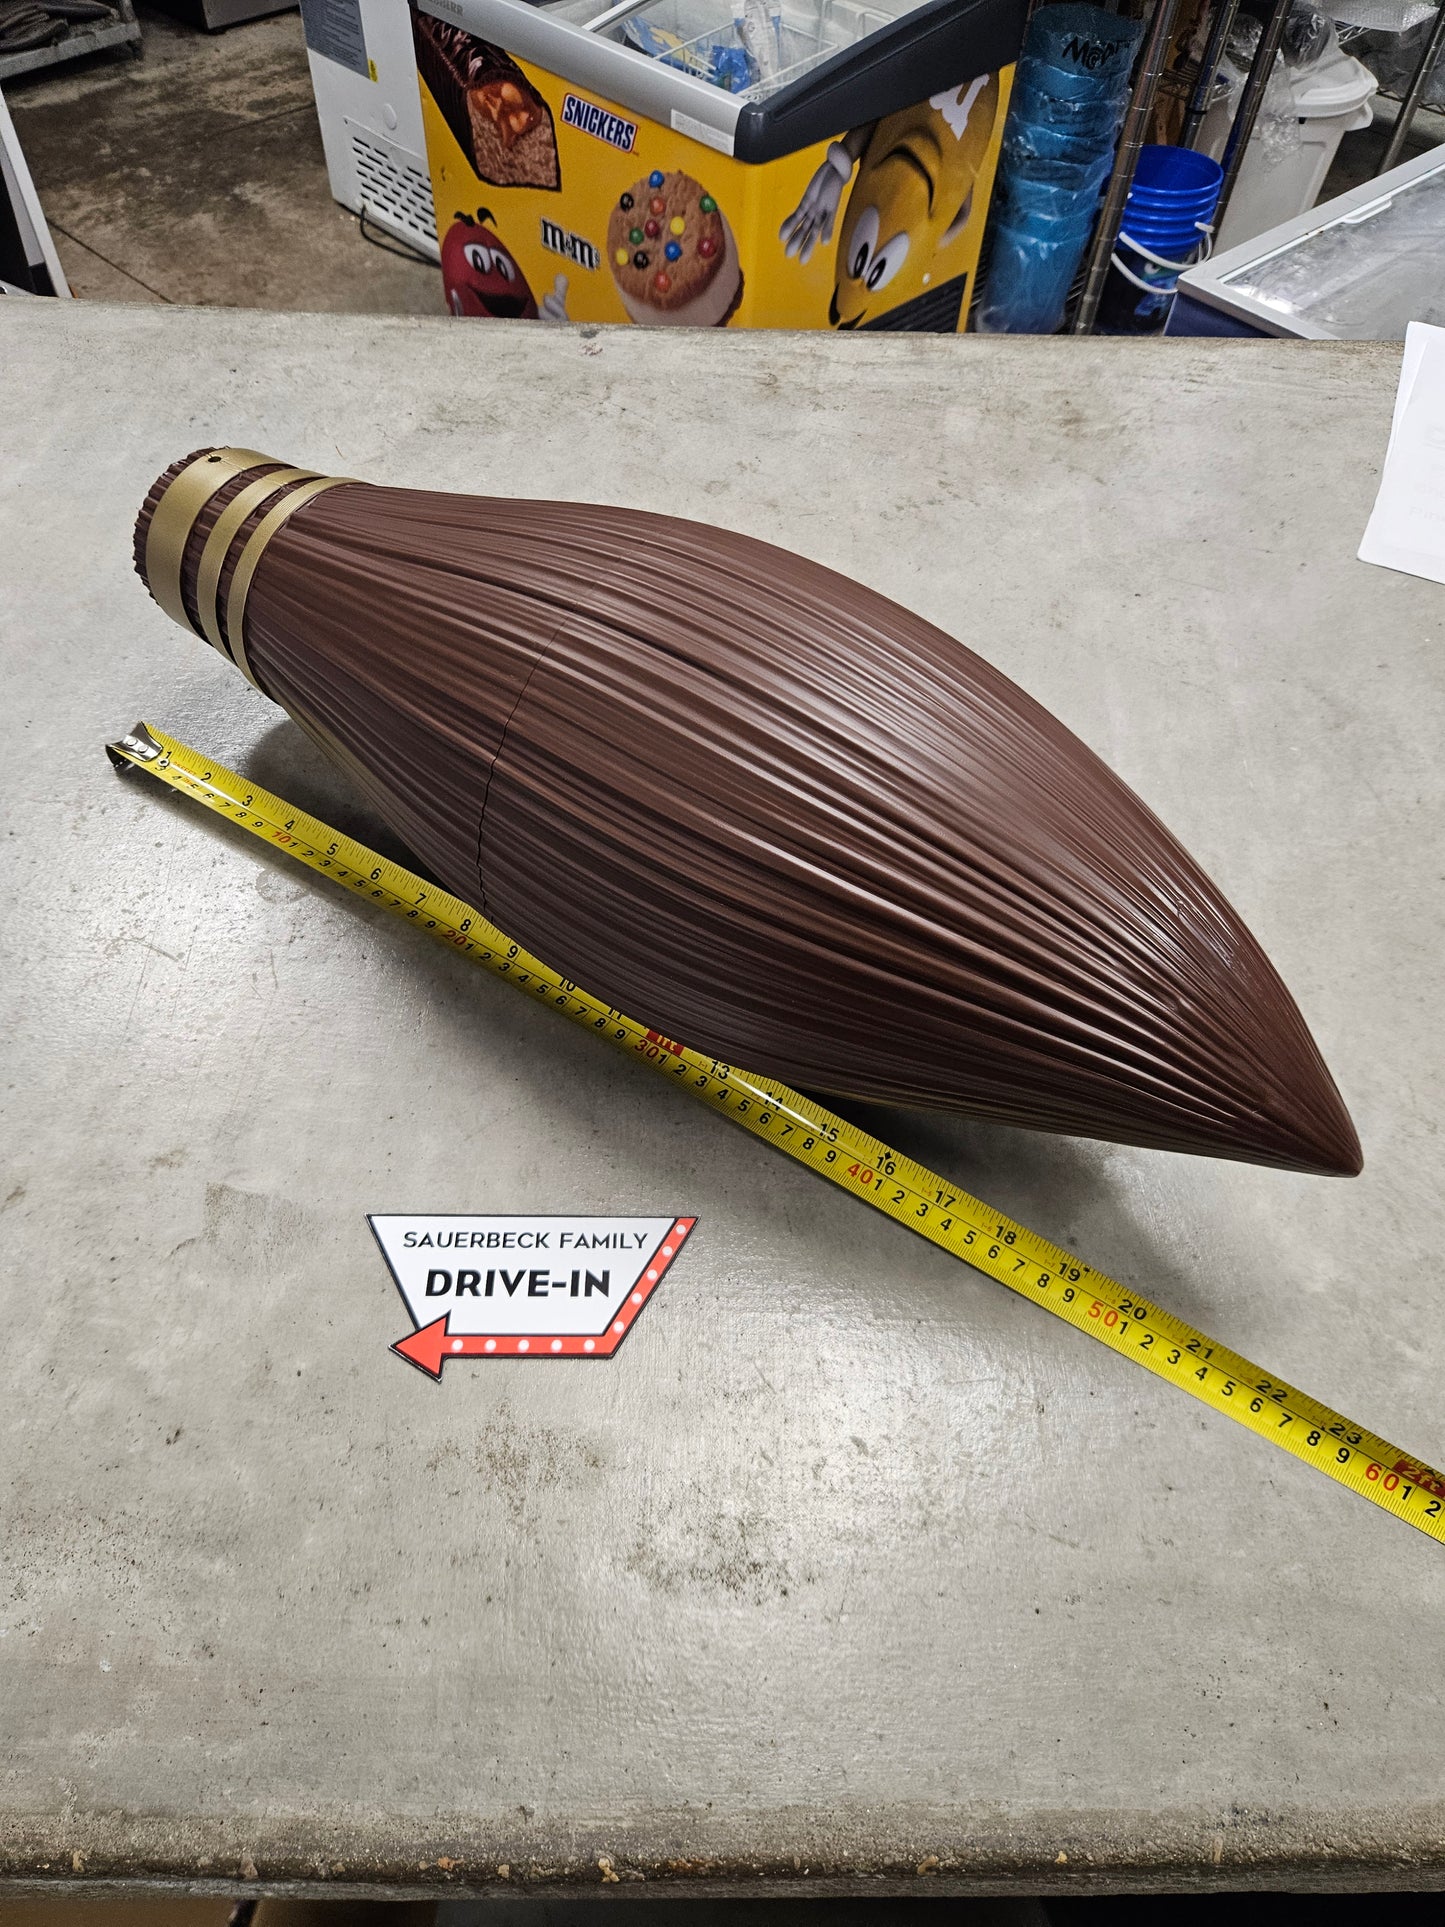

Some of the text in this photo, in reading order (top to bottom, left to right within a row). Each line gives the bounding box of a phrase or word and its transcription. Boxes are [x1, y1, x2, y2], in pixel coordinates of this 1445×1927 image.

[563, 95, 635, 151] SNICKERS
[200, 772, 212, 782] 2
[241, 795, 253, 807] 3
[284, 819, 296, 831] 4
[326, 842, 339, 855] 5
[370, 867, 382, 880] 6
[414, 892, 427, 905] 7
[459, 918, 472, 932] 8
[506, 945, 519, 959] 9
[559, 978, 576, 992] 10
[710, 1060, 730, 1080] 13
[763, 1091, 784, 1111] 14
[819, 1123, 840, 1143] 15
[876, 1156, 897, 1176] 16
[935, 1190, 957, 1208] 17
[995, 1225, 1017, 1245] 18
[1058, 1261, 1081, 1282] 19
[1118, 1298, 1147, 1320] 20
[1186, 1338, 1214, 1360] 21
[1255, 1379, 1288, 1403] 22
[1328, 1422, 1363, 1445] 23
[251, 821, 264, 829] 9
[272, 831, 291, 843] 10
[302, 850, 314, 858] 2
[319, 860, 331, 868] 3
[337, 869, 348, 878] 4
[354, 879, 366, 887] 5
[371, 889, 383, 898] 6
[389, 900, 401, 908] 7
[407, 910, 419, 919] 8
[425, 920, 436, 929] 9
[442, 930, 467, 946] 20
[465, 943, 474, 951] 1
[479, 952, 492, 962] 2
[498, 962, 510, 972] 3
[518, 974, 529, 983] 4
[536, 984, 549, 994] 5
[555, 995, 567, 1005] 6
[575, 1006, 587, 1016] 7
[594, 1017, 606, 1028] 8
[614, 1029, 626, 1040] 9
[634, 1039, 660, 1059] 30
[657, 1054, 668, 1065] 1
[673, 1064, 687, 1076] 2
[695, 1075, 708, 1087] 3
[717, 1088, 729, 1101] 4
[738, 1100, 751, 1112] 5
[759, 1112, 771, 1125] 6
[780, 1124, 794, 1137] 7
[802, 1137, 815, 1150] 8
[824, 1150, 837, 1163] 9
[847, 1162, 874, 1185] 40
[873, 1179, 884, 1191] 1
[891, 1190, 905, 1204] 2
[915, 1203, 929, 1217] 3
[940, 1218, 952, 1232] 4
[963, 1230, 977, 1245] 5
[987, 1244, 1001, 1259] 6
[1011, 1258, 1026, 1273] 7
[1036, 1273, 1050, 1288] 8
[1062, 1287, 1075, 1303] 9
[1087, 1299, 1119, 1328] 50
[1118, 1321, 1129, 1335] 1
[1139, 1334, 1154, 1350] 2
[1166, 1349, 1181, 1365] 3
[1195, 1366, 1208, 1382] 4
[1221, 1380, 1237, 1397] 5
[1249, 1397, 1264, 1413] 6
[1277, 1412, 1293, 1429] 7
[1306, 1430, 1321, 1447] 8
[1335, 1447, 1350, 1464] 9
[1365, 1462, 1400, 1492] 60
[1402, 1485, 1413, 1501] 1
[1424, 1500, 1442, 1518] 2
[402, 1230, 649, 1249] SAUERBECK FAMILY
[424, 1268, 611, 1298] DRIVE-IN
